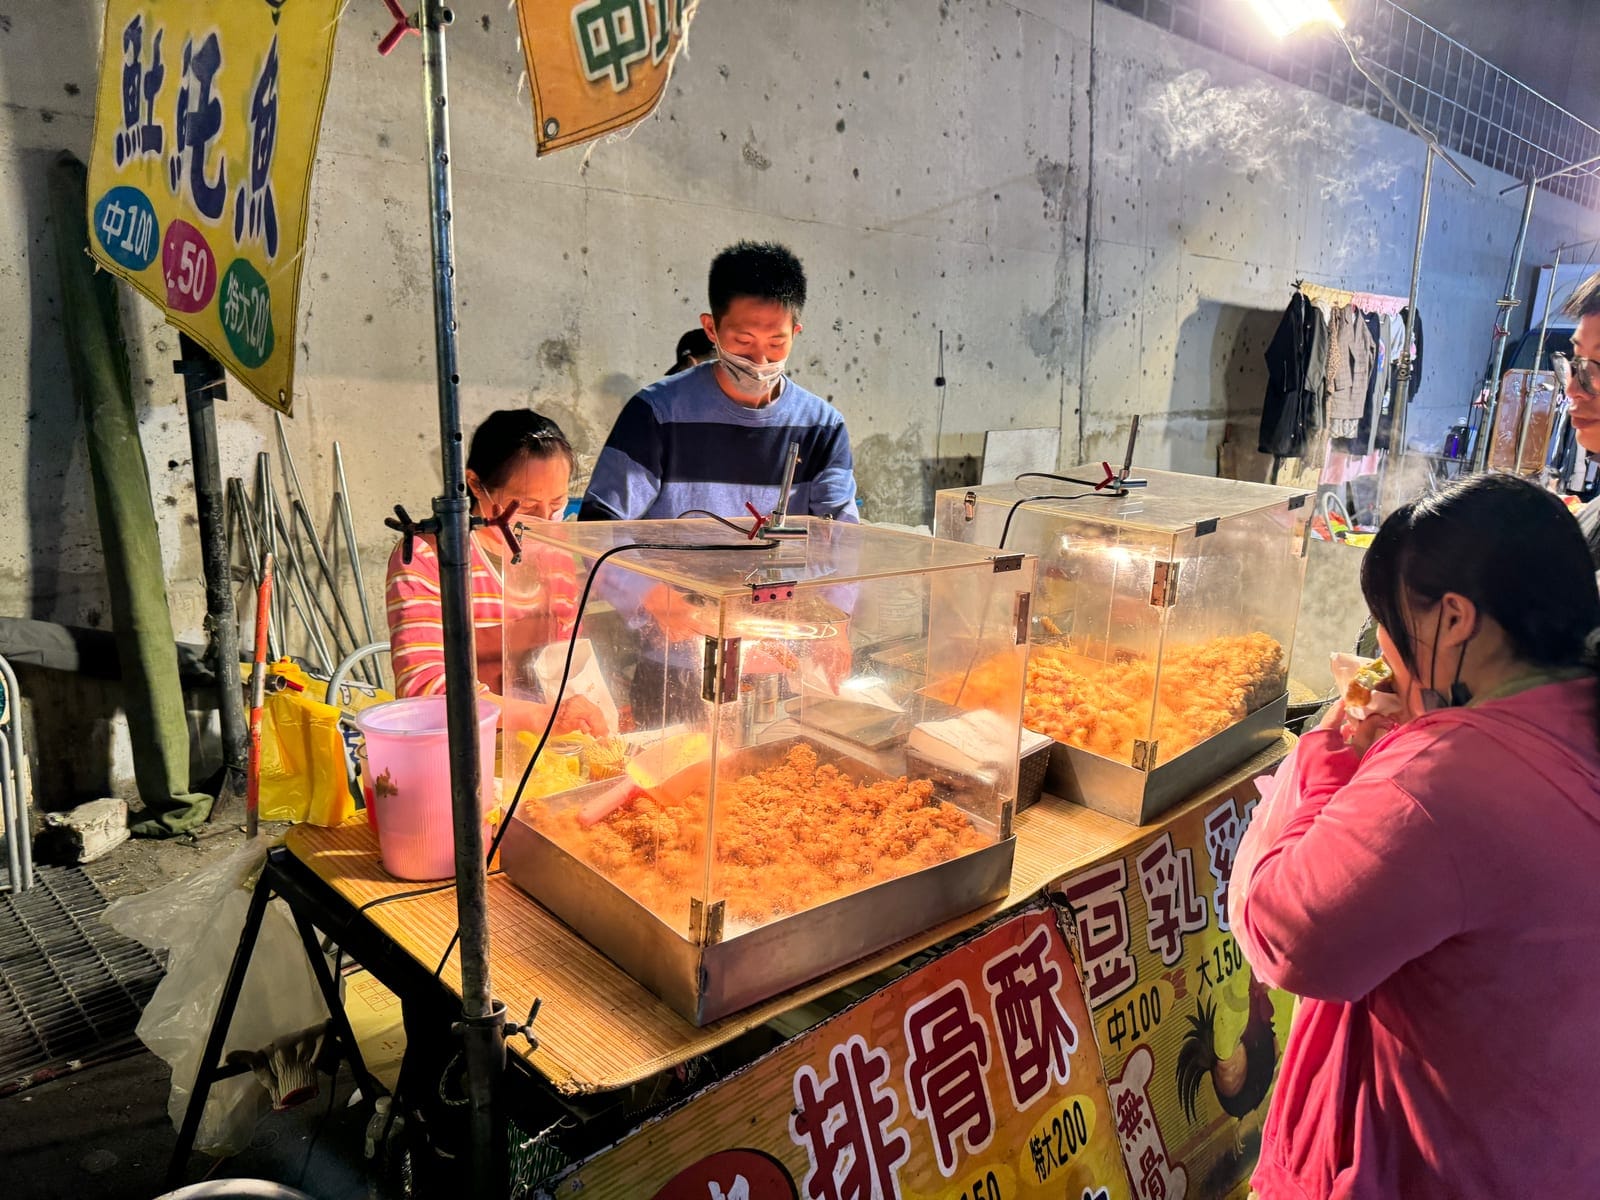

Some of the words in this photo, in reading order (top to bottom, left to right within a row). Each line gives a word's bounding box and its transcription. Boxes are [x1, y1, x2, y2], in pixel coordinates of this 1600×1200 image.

[102, 200, 153, 262] 中100
[1196, 937, 1243, 995] 大150
[1107, 985, 1161, 1052] 中100
[790, 924, 1078, 1200] 排骨酥
[1030, 1100, 1087, 1184] 特大200
